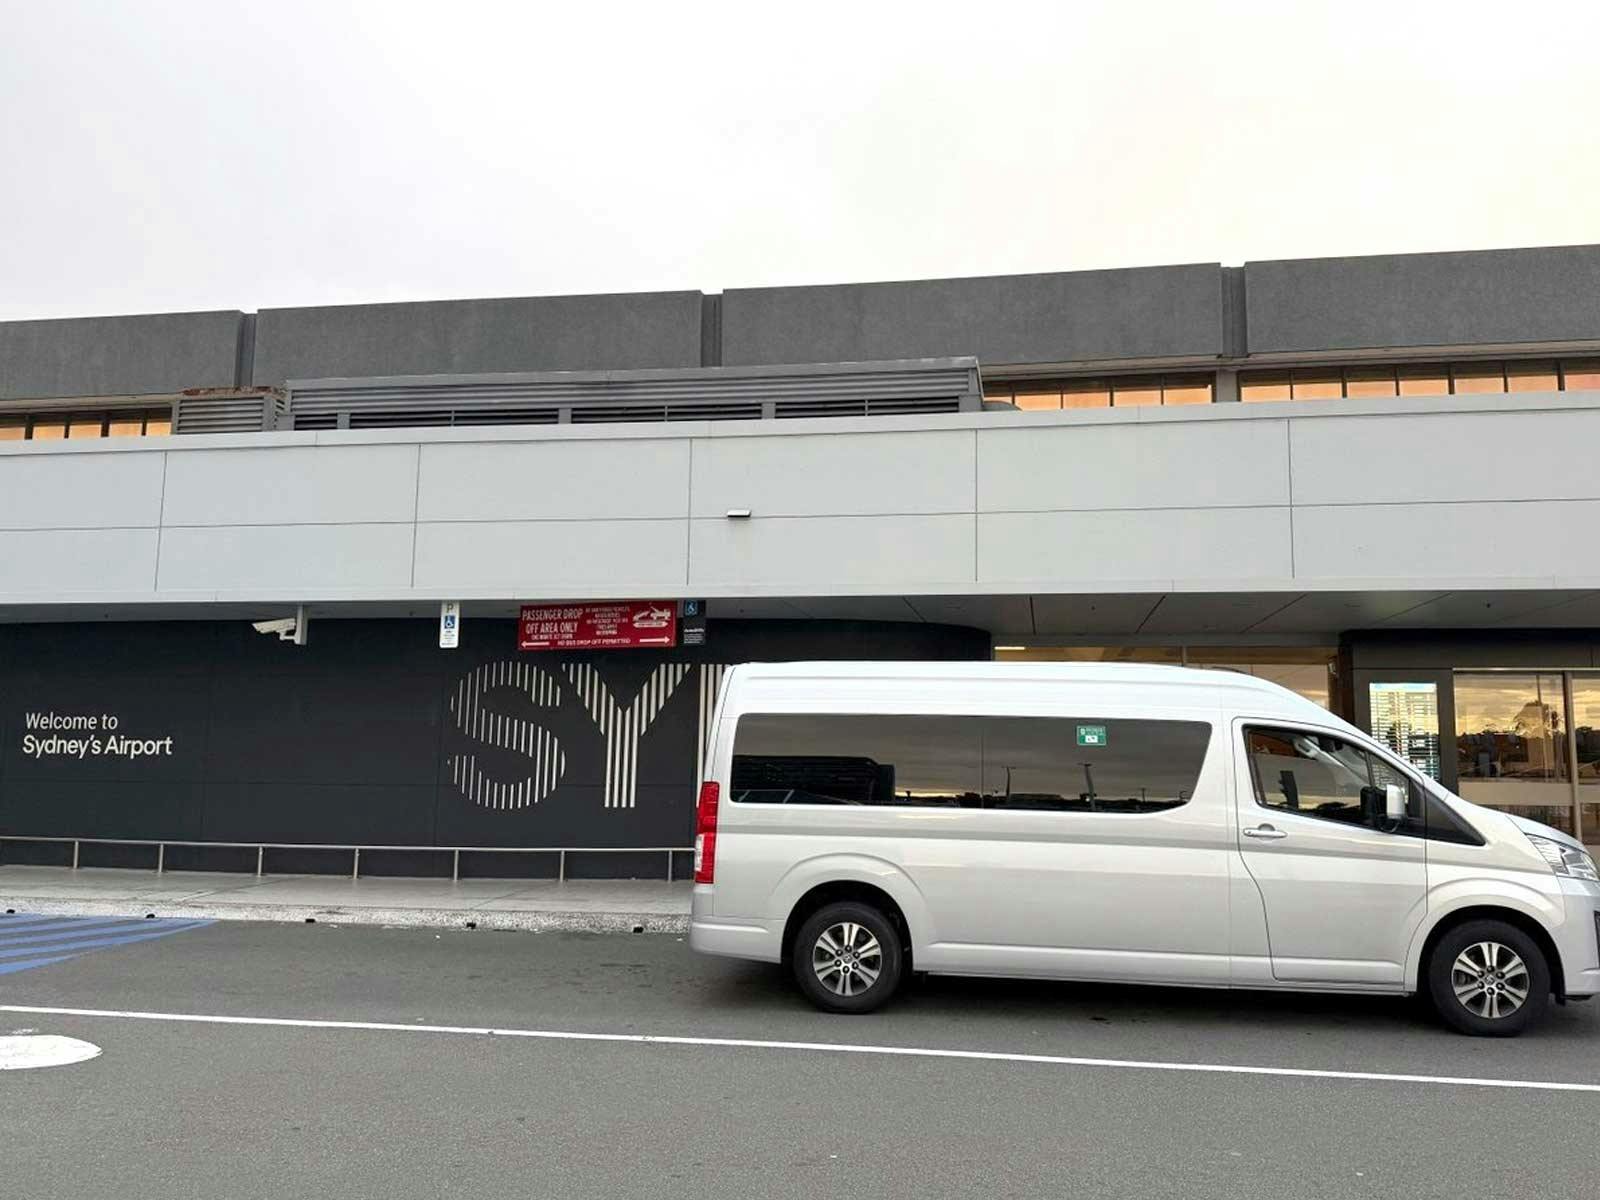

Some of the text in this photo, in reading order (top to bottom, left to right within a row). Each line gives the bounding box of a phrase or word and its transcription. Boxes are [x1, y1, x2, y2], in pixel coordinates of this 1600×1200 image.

[521, 608, 562, 621] PASSENGER
[562, 607, 584, 620] DROP
[525, 622, 539, 635] OFF
[540, 622, 559, 634] AREA
[560, 621, 579, 633] ONLY
[25, 711, 119, 730] Welcome to
[22, 734, 173, 760] Sydney's Airport
